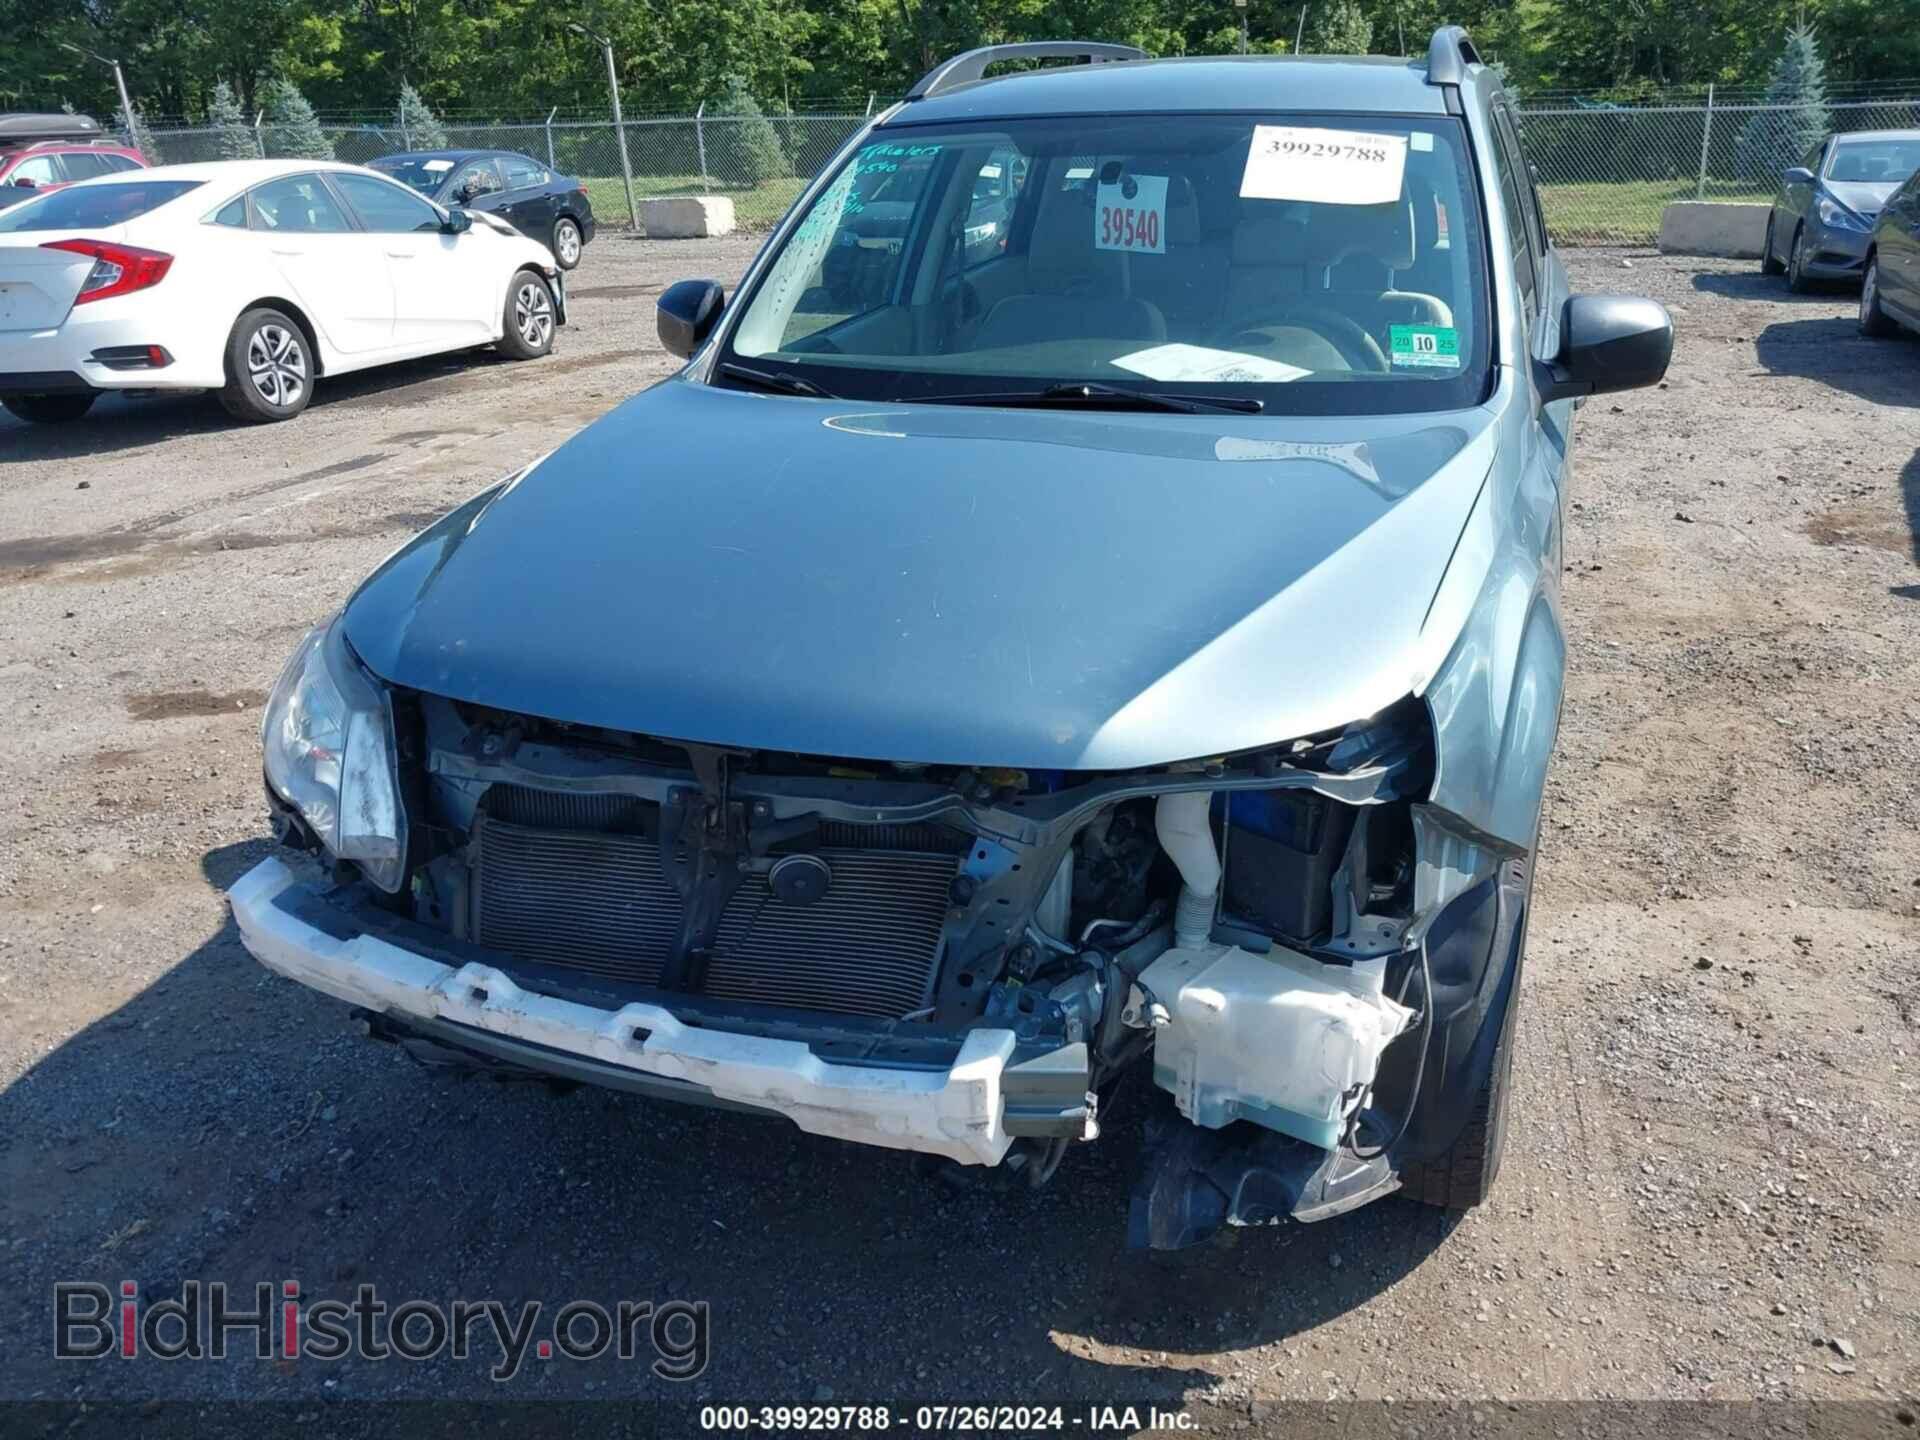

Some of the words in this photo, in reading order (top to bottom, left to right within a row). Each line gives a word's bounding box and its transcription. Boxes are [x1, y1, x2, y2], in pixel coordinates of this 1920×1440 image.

[1265, 140, 1387, 163] 39929788
[1102, 206, 1159, 249] 39540
[1395, 336, 1410, 347] 20
[1415, 336, 1433, 351] 10
